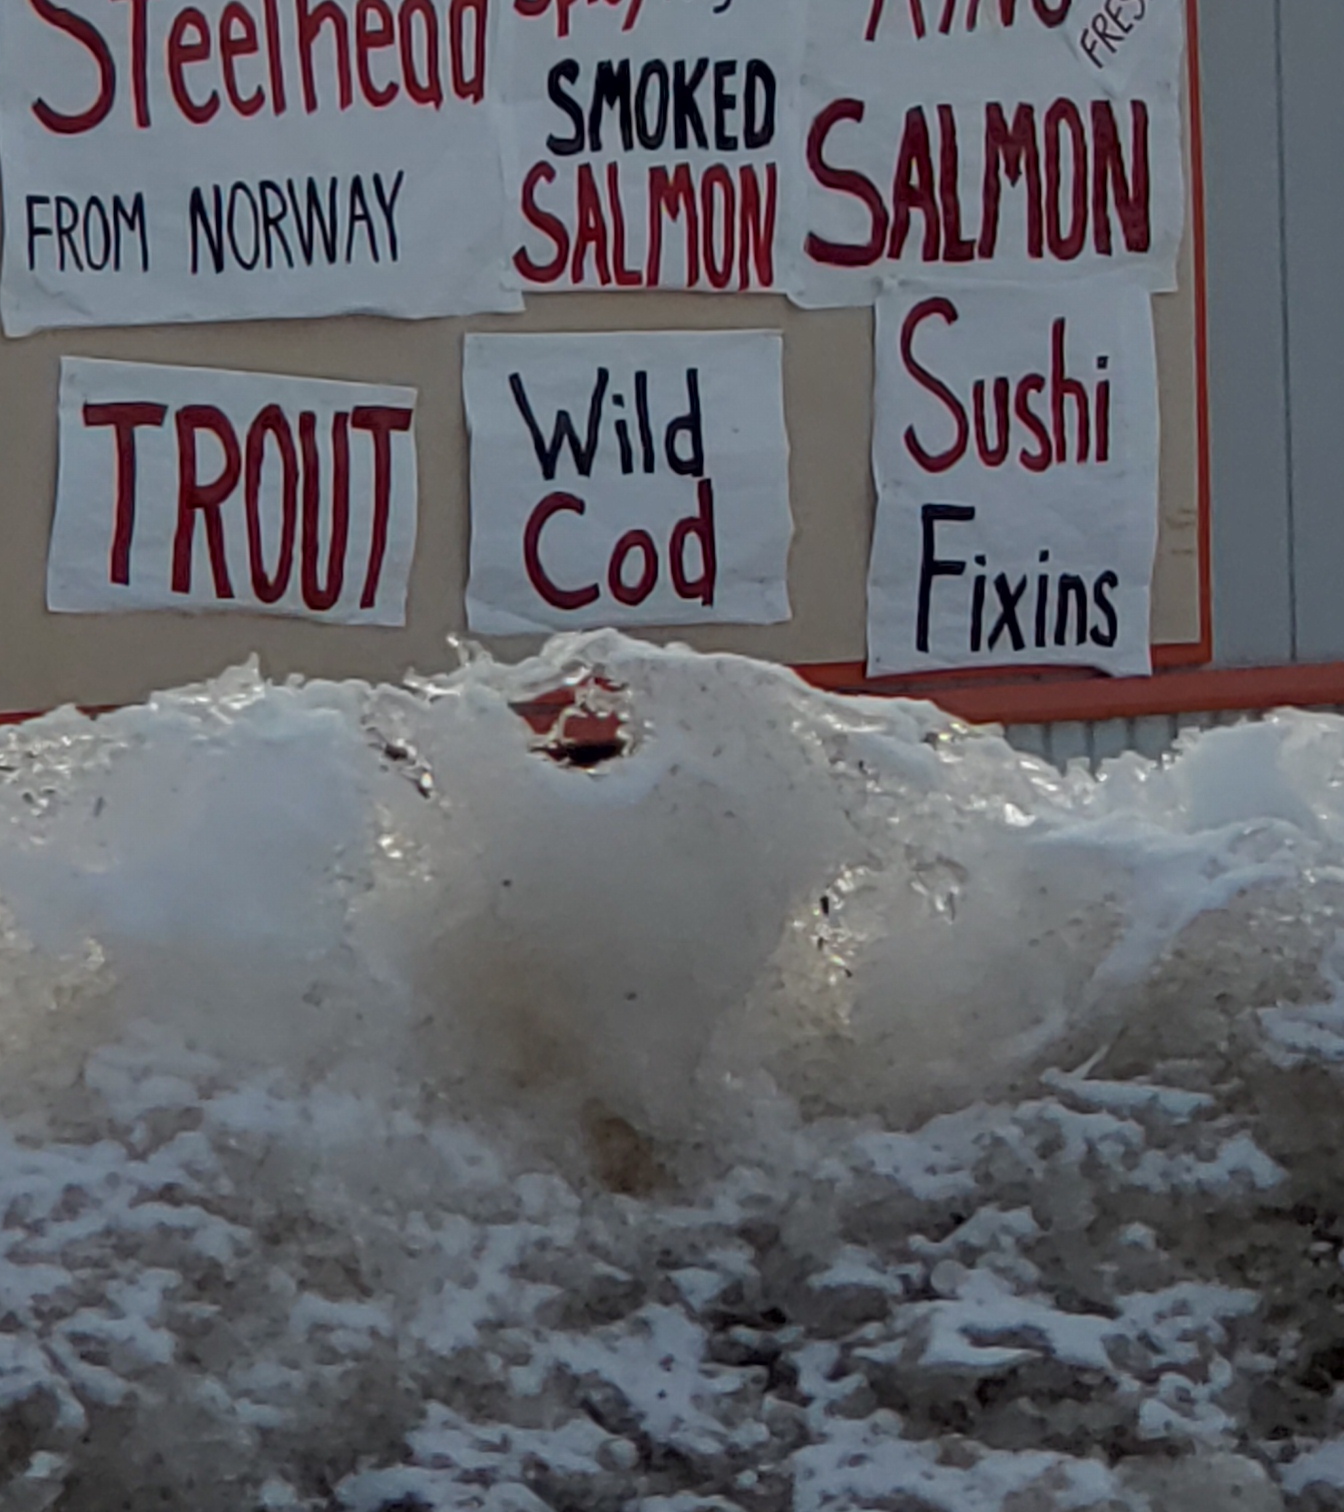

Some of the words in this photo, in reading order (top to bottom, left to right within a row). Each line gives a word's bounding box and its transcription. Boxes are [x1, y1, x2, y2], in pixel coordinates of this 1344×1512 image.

[545, 57, 777, 156] SMOKED
[24, 191, 149, 273] FROM
[188, 169, 406, 275] NORWAY
[511, 159, 778, 291] SALMON
[803, 97, 1151, 267] SALMON
[508, 366, 705, 481] Wild
[899, 296, 1111, 473] Sushi
[82, 401, 414, 612] TROUT
[522, 477, 717, 610] Cod
[916, 503, 1120, 653] Fixins
